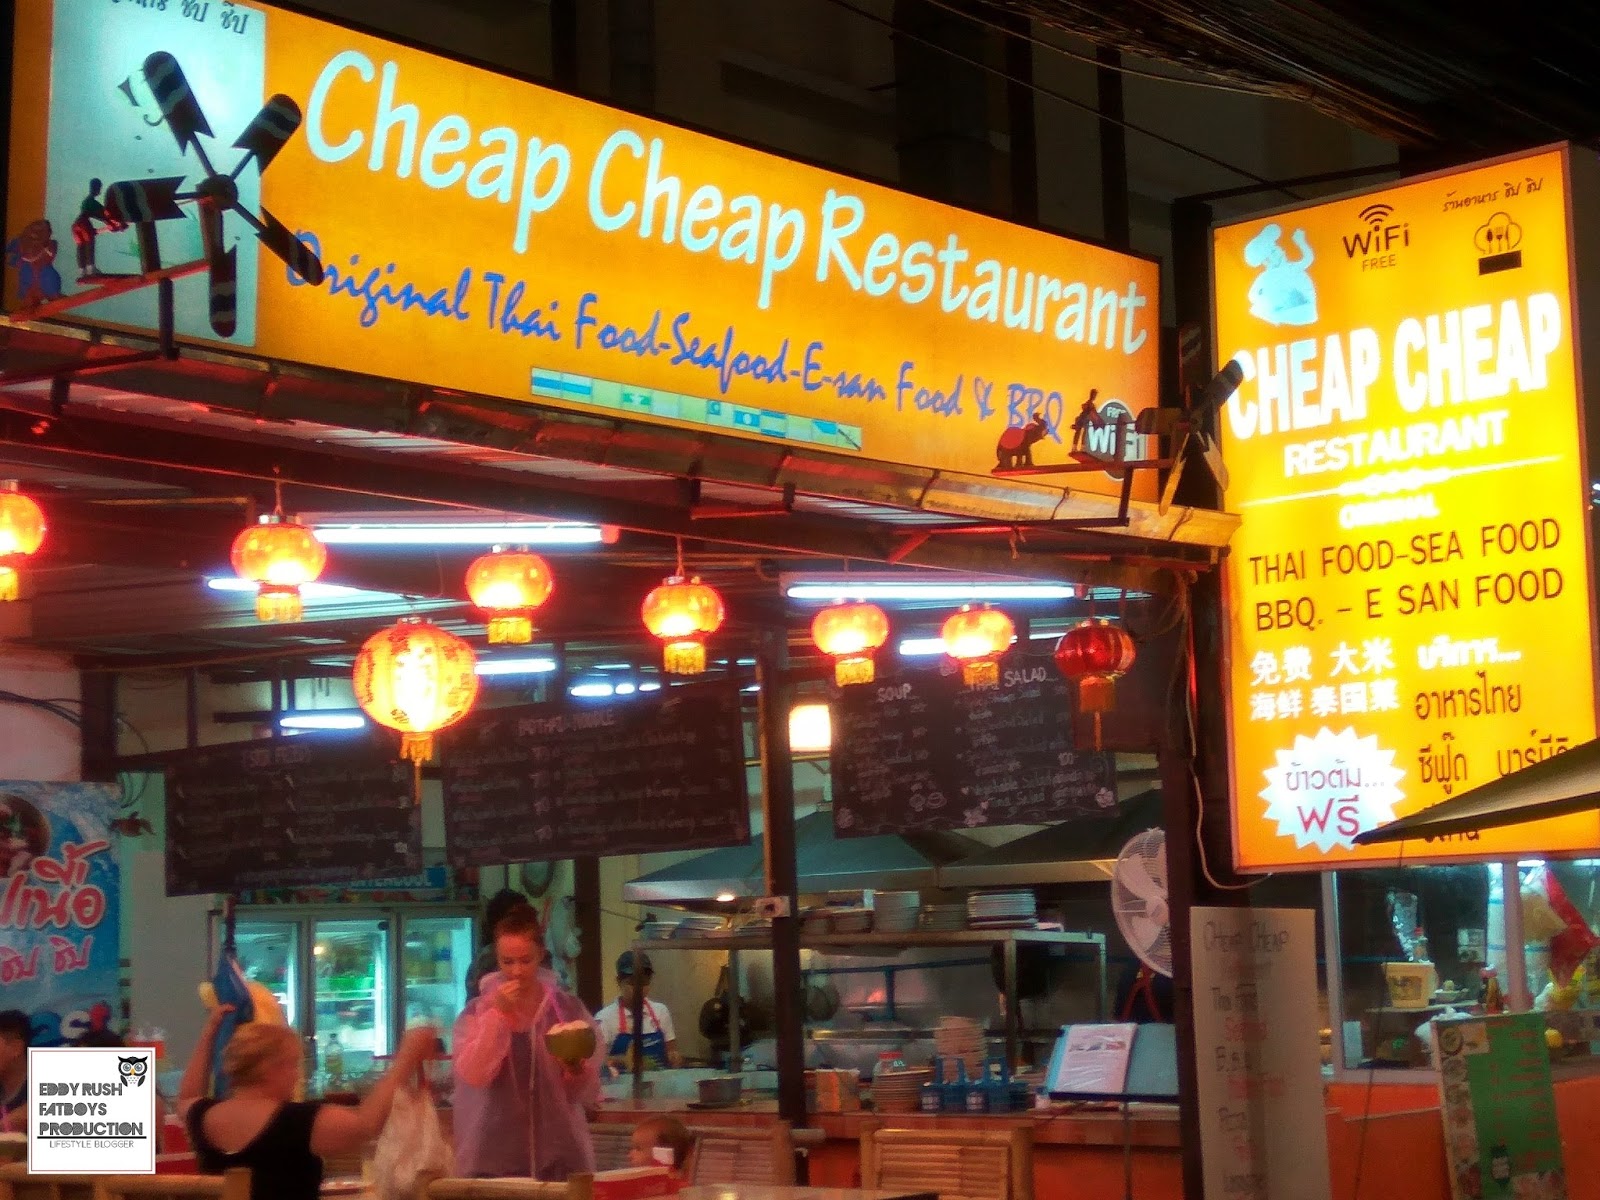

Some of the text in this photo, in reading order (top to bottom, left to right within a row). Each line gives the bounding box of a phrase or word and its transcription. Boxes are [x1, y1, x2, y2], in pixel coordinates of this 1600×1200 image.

[305, 50, 1147, 356] Cheap Cheap Restaurant
[1342, 222, 1409, 259] WiFi
[1362, 253, 1396, 272] FREE
[286, 229, 473, 328] Original
[483, 271, 561, 341] Thai
[896, 360, 963, 417] Food
[1007, 382, 1063, 444] BBQ
[1225, 291, 1563, 441] CHEAP CHEAP
[1283, 409, 1510, 478] RESTAURANT
[1249, 550, 1307, 585] THAI
[1480, 518, 1561, 556] FOOD
[1366, 588, 1384, 619] E
[1398, 578, 1460, 616] SAN
[1475, 567, 1564, 608] FOOD
[1004, 666, 1047, 688] SALAD
[1329, 637, 1396, 677] 大米
[877, 683, 912, 702] SOUP
[1415, 670, 1522, 721] อาหารไทย
[1297, 794, 1360, 837] ฟรี
